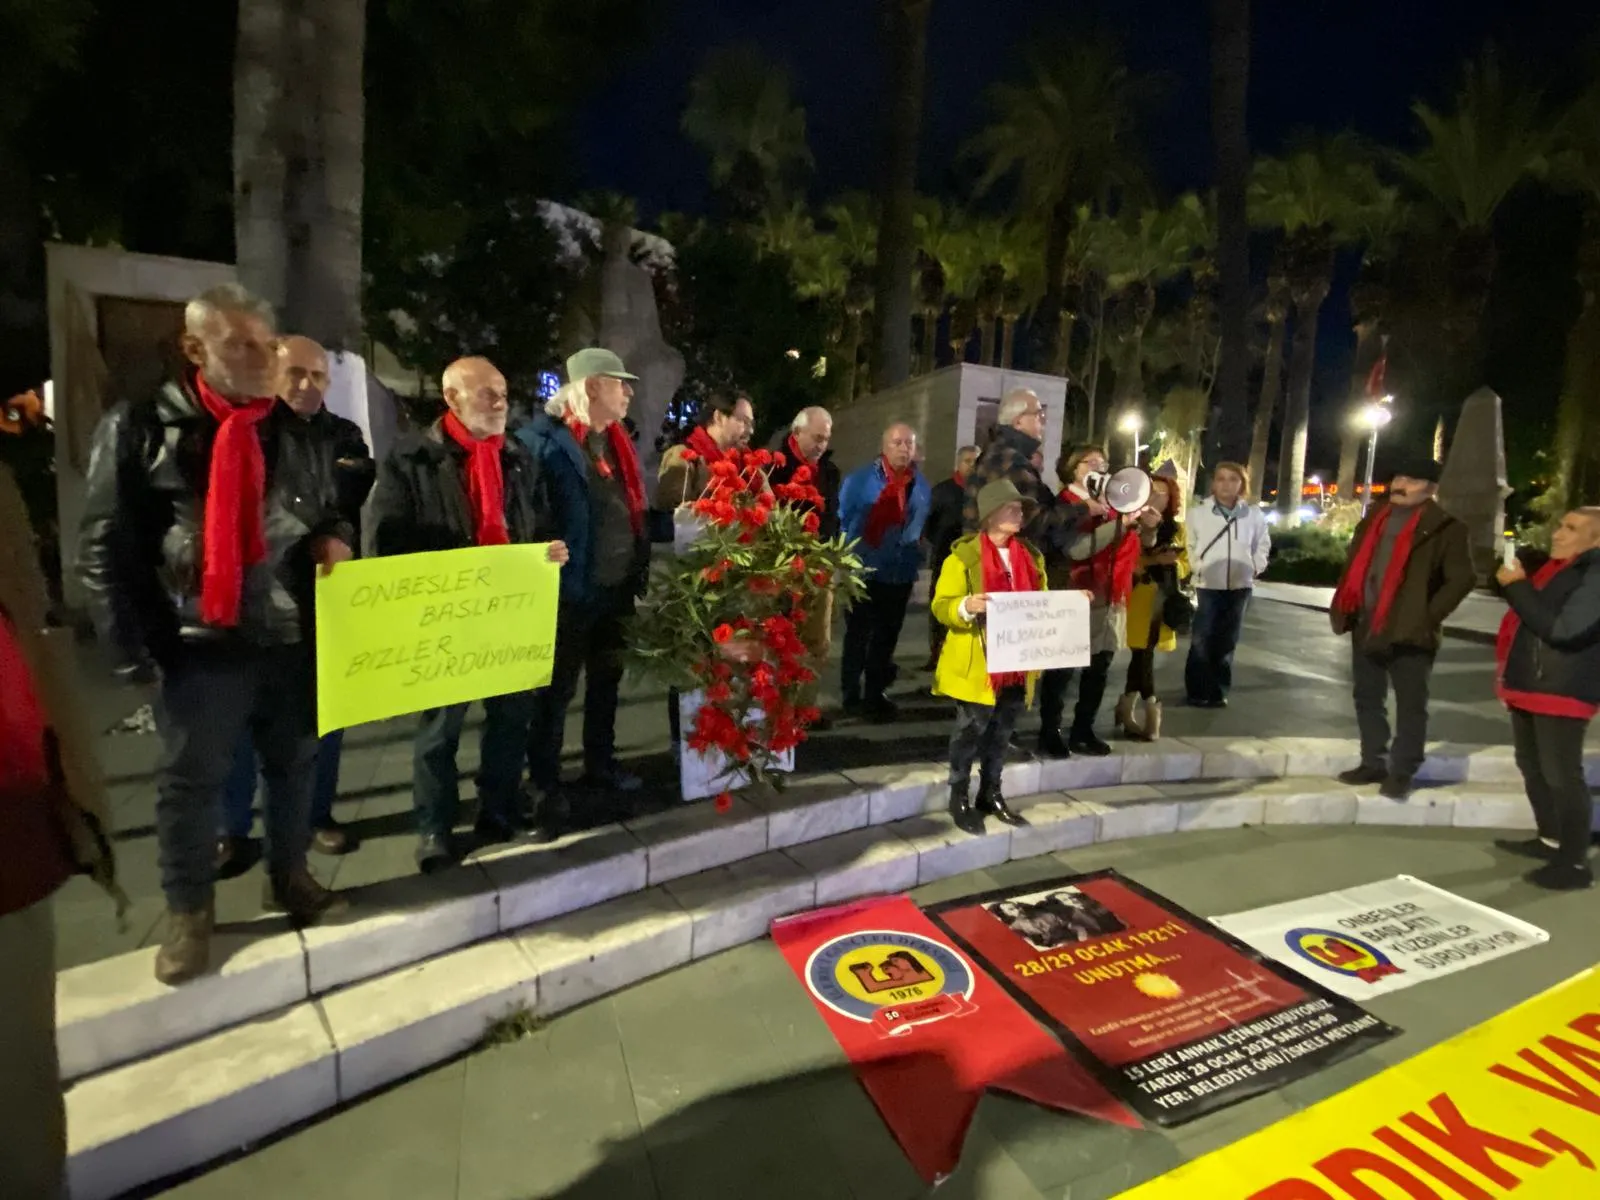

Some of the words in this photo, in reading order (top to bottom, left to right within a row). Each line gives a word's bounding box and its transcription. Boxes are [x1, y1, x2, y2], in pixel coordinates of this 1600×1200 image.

[350, 566, 492, 609] ONBESLER
[419, 592, 536, 627] BASLATTI
[1014, 953, 1075, 977] 28/29
[1074, 938, 1132, 961] OCAK
[1073, 952, 1182, 985] UNUTMA...
[889, 987, 923, 1000] 1976
[1123, 1065, 1144, 1080] 15
[1141, 1052, 1179, 1074] LERİ
[1176, 1038, 1226, 1062] ANMAK
[1249, 998, 1334, 1035] BULUŞUYORUZ
[1137, 1071, 1192, 1094] TARİH:
[1187, 1062, 1210, 1076] 28
[1207, 1050, 1246, 1069] OCAK
[1153, 1090, 1193, 1109] YER:
[1188, 1064, 1257, 1097] BELEDİYE
